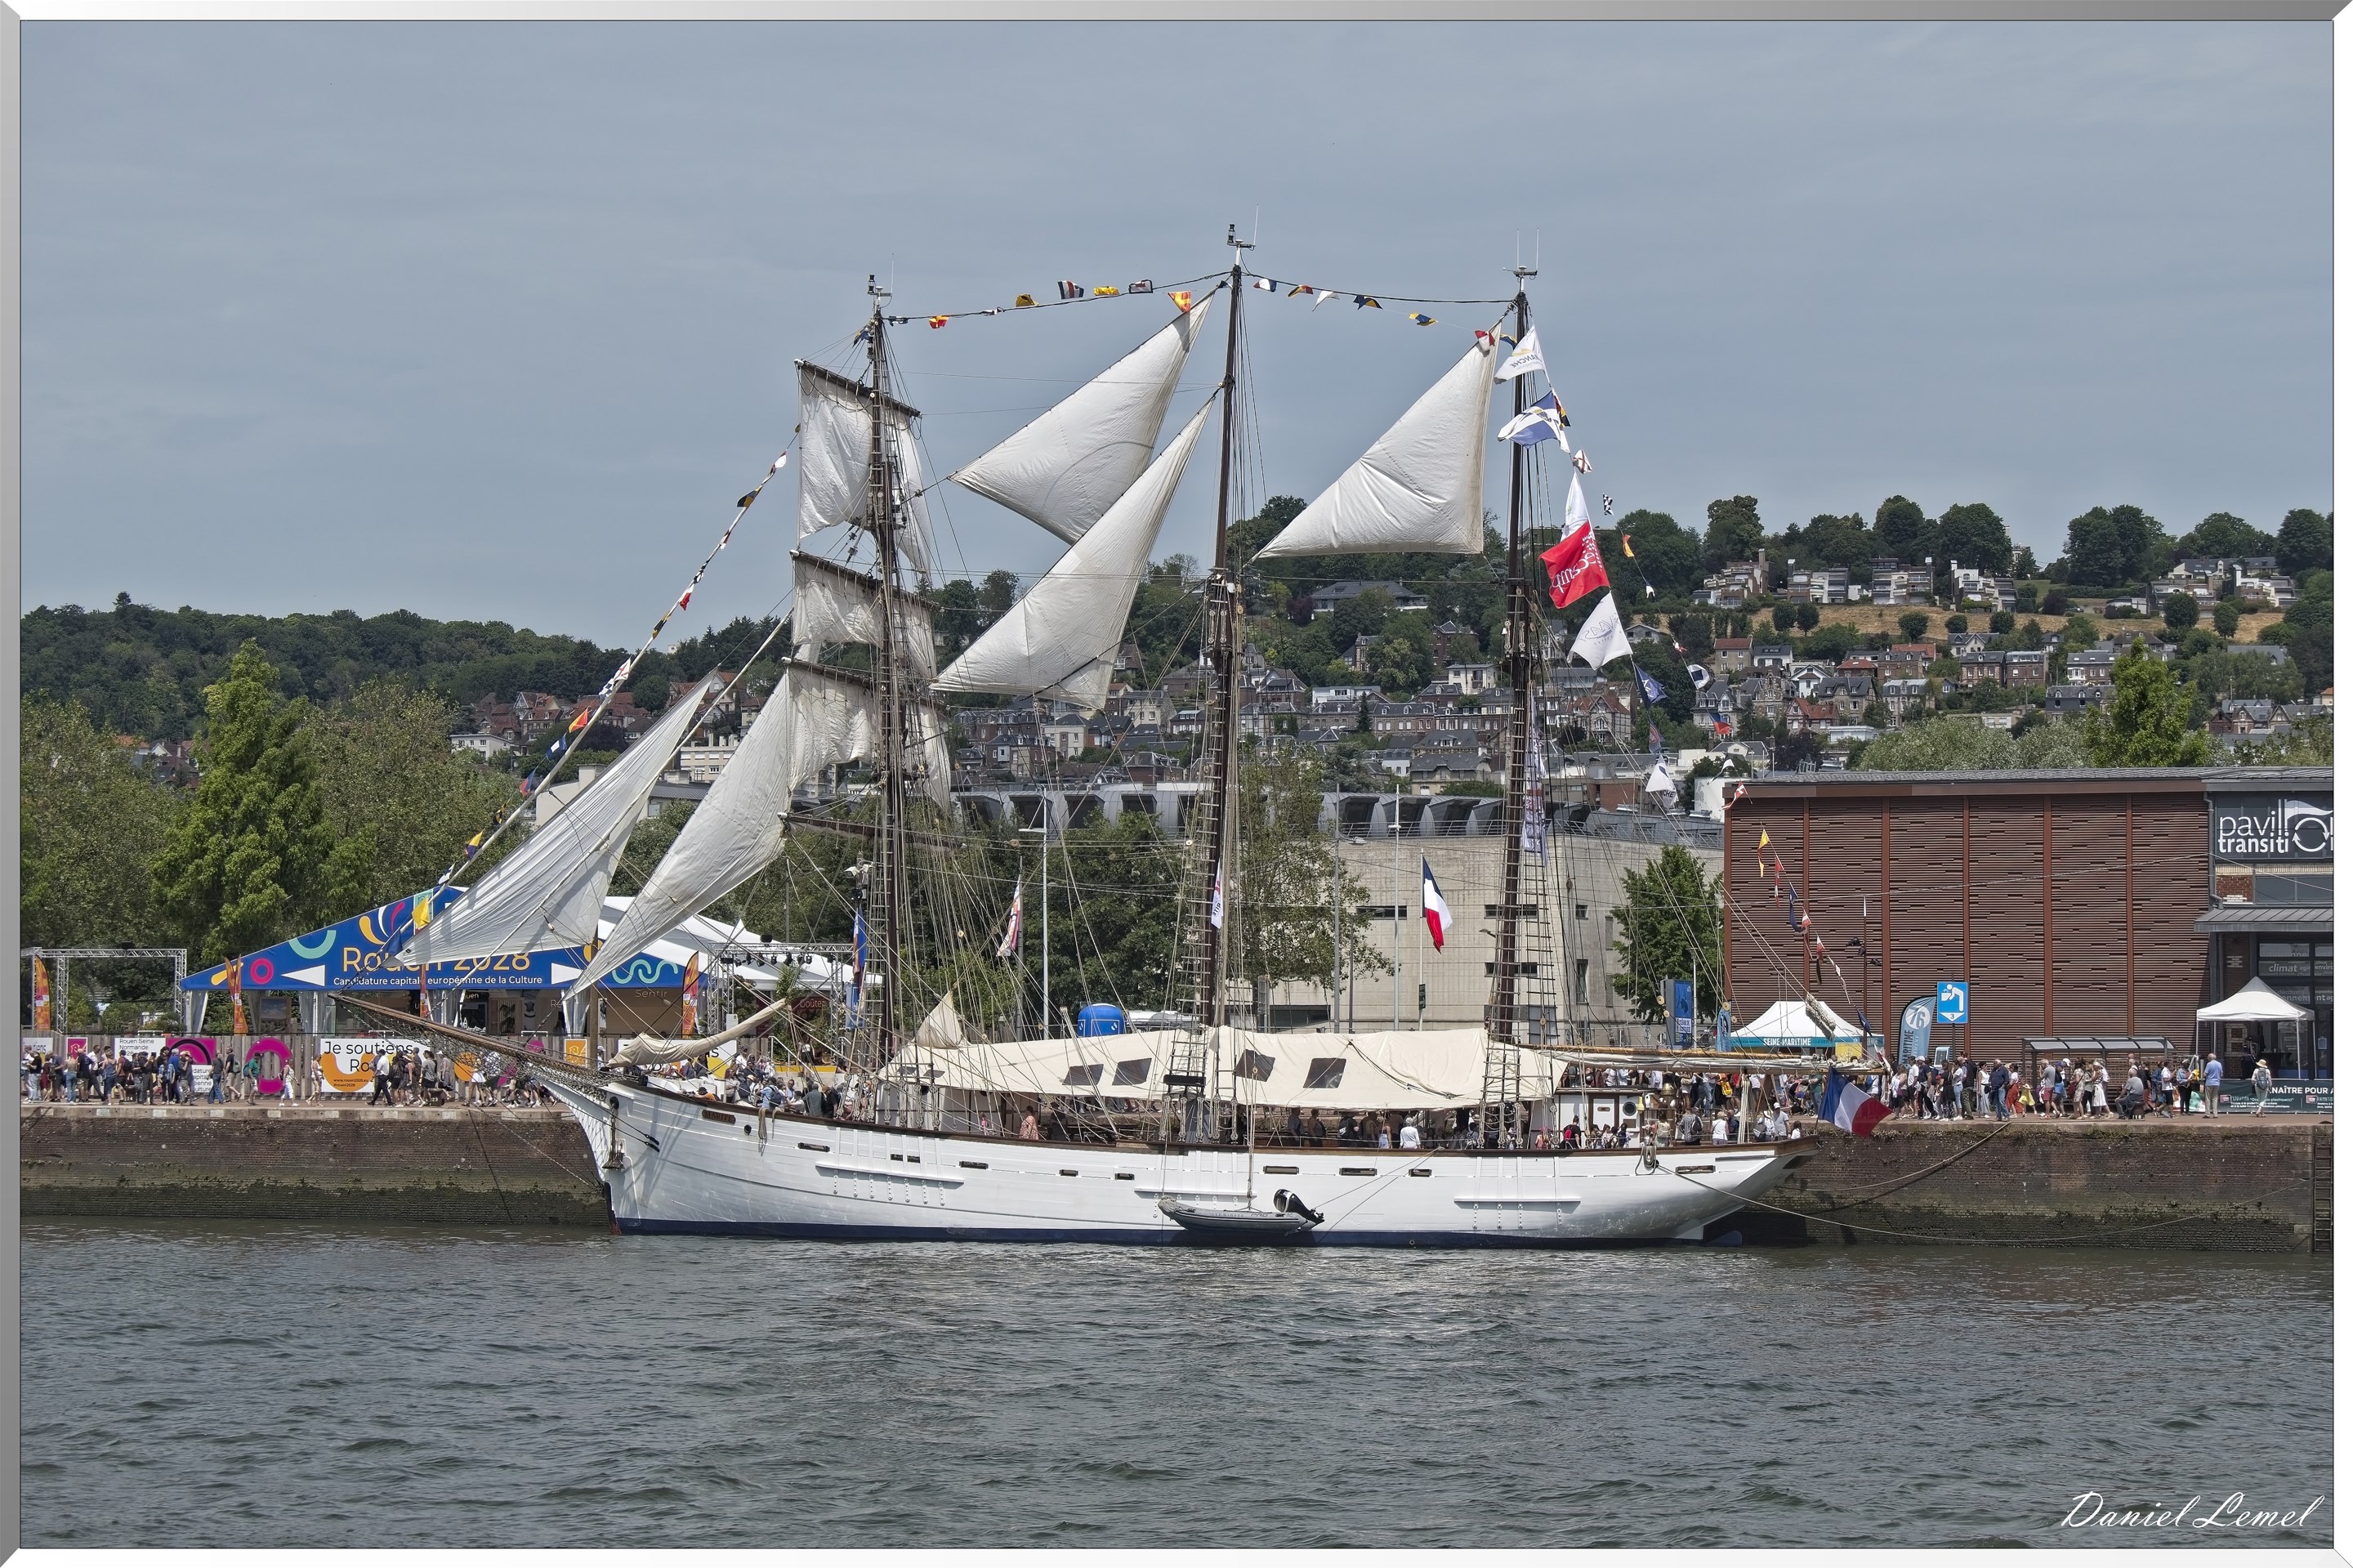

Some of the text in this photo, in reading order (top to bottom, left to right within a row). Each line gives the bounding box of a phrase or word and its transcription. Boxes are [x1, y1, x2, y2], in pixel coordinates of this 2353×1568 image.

[2269, 963, 2297, 972] climat
[333, 977, 388, 985] Candidature
[390, 976, 420, 986] capital
[508, 976, 542, 984] Culture
[635, 989, 668, 998] Sentir
[1907, 1007, 1926, 1029] 76
[1763, 1038, 1811, 1046] SEINE-MARITIME
[324, 1041, 413, 1054] Je soutiens
[2270, 1085, 2303, 1094] NAÎTRE
